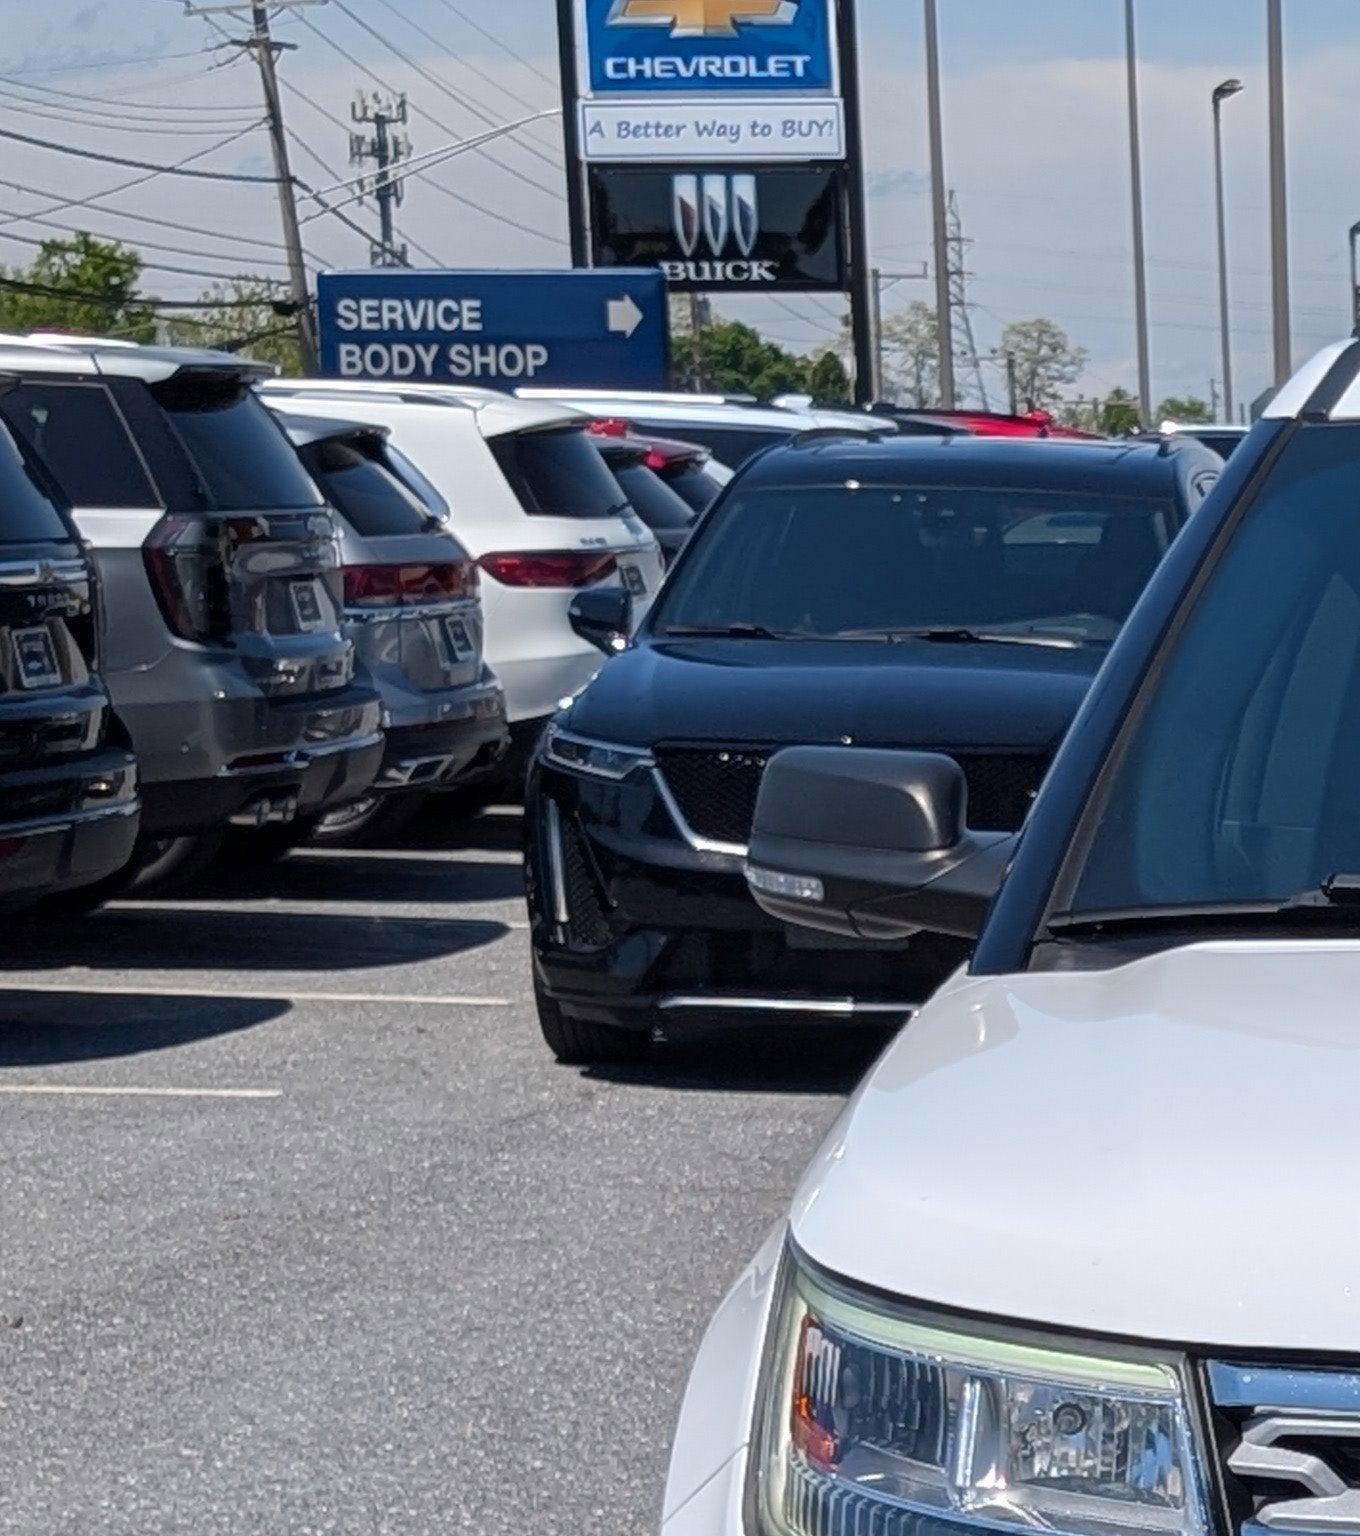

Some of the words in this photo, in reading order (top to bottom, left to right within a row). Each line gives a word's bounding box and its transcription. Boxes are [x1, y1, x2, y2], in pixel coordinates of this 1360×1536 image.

[604, 55, 811, 80] CHEVROLET
[588, 122, 606, 139] A
[616, 120, 686, 139] Better
[694, 120, 741, 143] Way
[750, 121, 773, 139] to
[781, 119, 835, 138] BUY!
[659, 259, 780, 282] BUICK
[336, 298, 483, 332] SERVICE
[338, 343, 439, 377] BODY
[449, 344, 549, 378] SHOP
